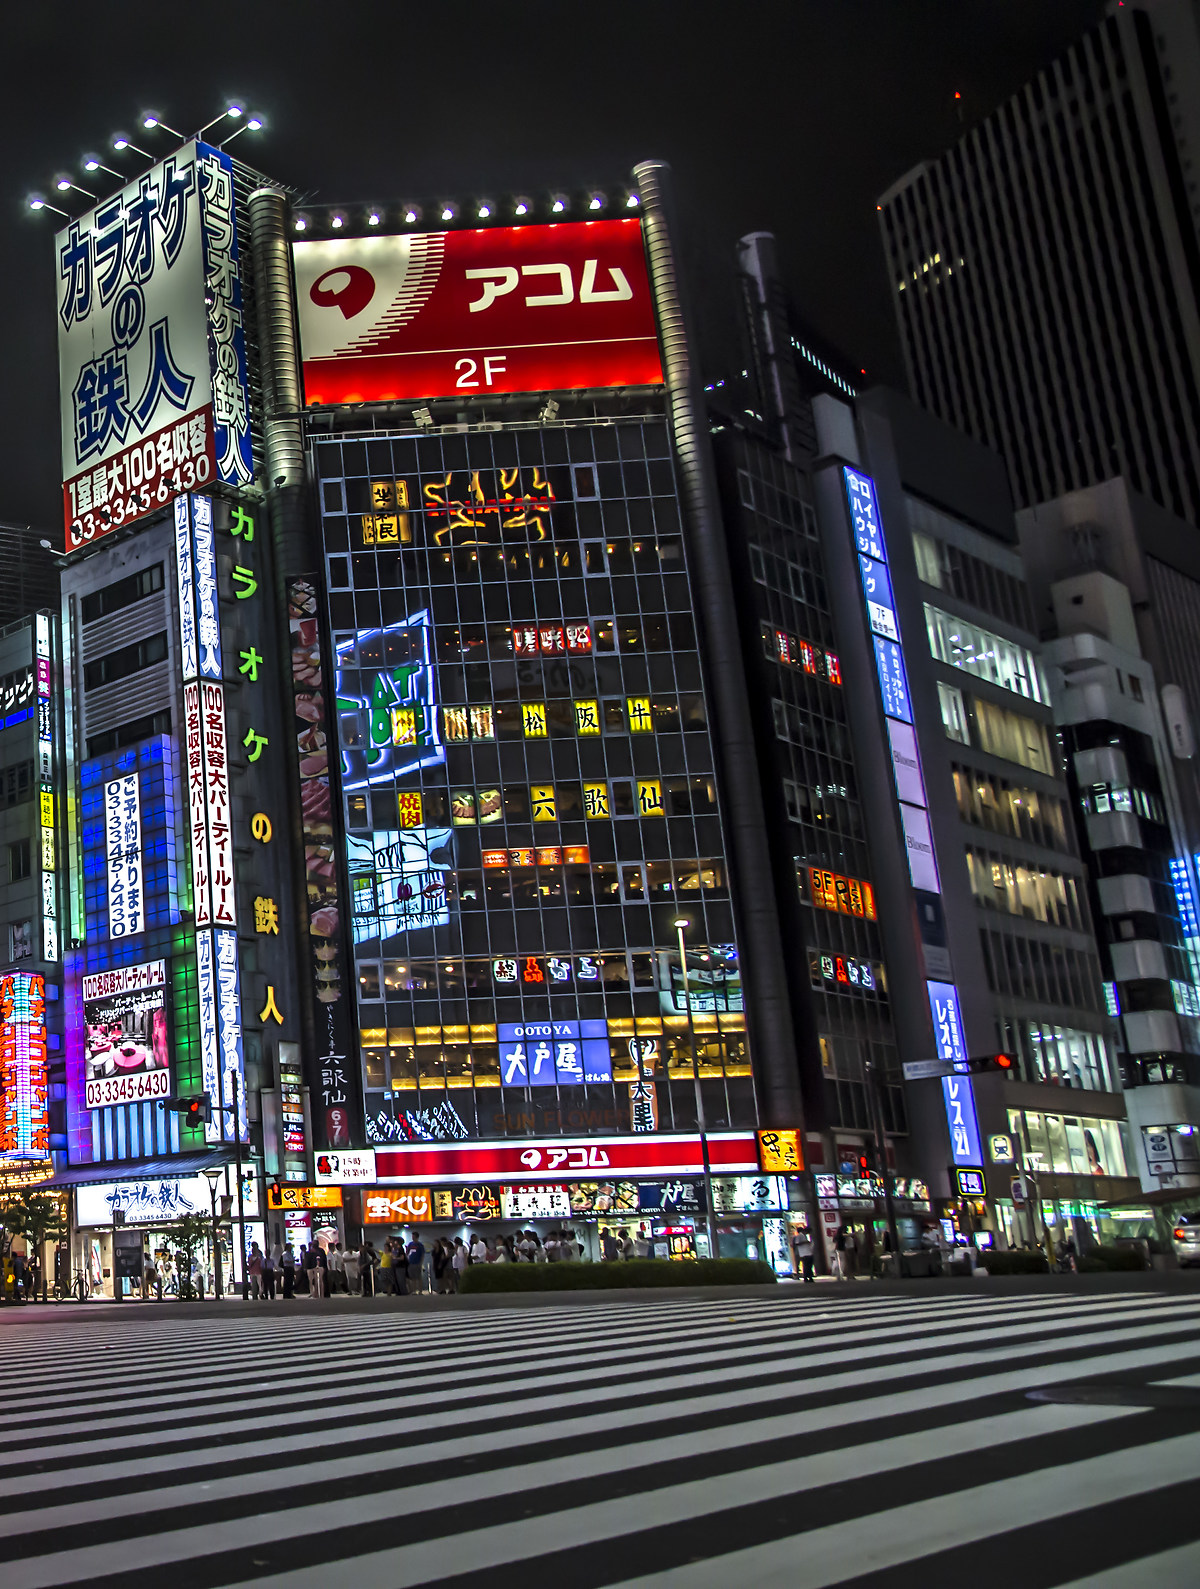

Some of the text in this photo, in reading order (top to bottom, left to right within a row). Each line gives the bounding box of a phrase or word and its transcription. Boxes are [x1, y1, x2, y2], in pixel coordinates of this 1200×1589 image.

[60, 157, 196, 332] カラオケ
[466, 259, 634, 313] アコム
[111, 282, 146, 349] の
[201, 153, 253, 484] カラオケの鉄人
[72, 316, 196, 466] 鉄人
[455, 356, 507, 388] 2F
[69, 415, 207, 520] 1室最大100名収容
[853, 497, 877, 592] ハウジング
[859, 481, 881, 558] ロイヤル
[176, 495, 196, 677] カラオケの鉄人
[194, 494, 222, 677] カラオケの鉄人
[525, 703, 651, 731] 松阪牛
[230, 506, 285, 1025] カラオケの鉄人
[202, 686, 233, 923] 100名収容大パーティールーム
[399, 792, 420, 828] 焼肉
[532, 785, 663, 818] 六歌仙
[107, 782, 126, 937] 03-3345-6430
[124, 776, 142, 932] ご予約承ります
[906, 836, 931, 854] Bloom
[812, 869, 832, 891] 5F
[84, 962, 164, 999] 100名収容大パーティールーム
[514, 1025, 572, 1037] OOTOYA
[1, 977, 20, 1151] パチンコジャンボ
[28, 976, 51, 1151] パチンコジャンボ
[319, 1051, 348, 1106] 六歌仙
[505, 1041, 583, 1084] 大戸屋
[493, 1109, 630, 1131] SUN FLOWER
[547, 1147, 610, 1169] アコム
[104, 1179, 194, 1217] カラオケの鉄人
[156, 1212, 172, 1220] 6430
[366, 1195, 428, 1218] 宝くじ
[660, 1180, 698, 1208] 大戸屋
